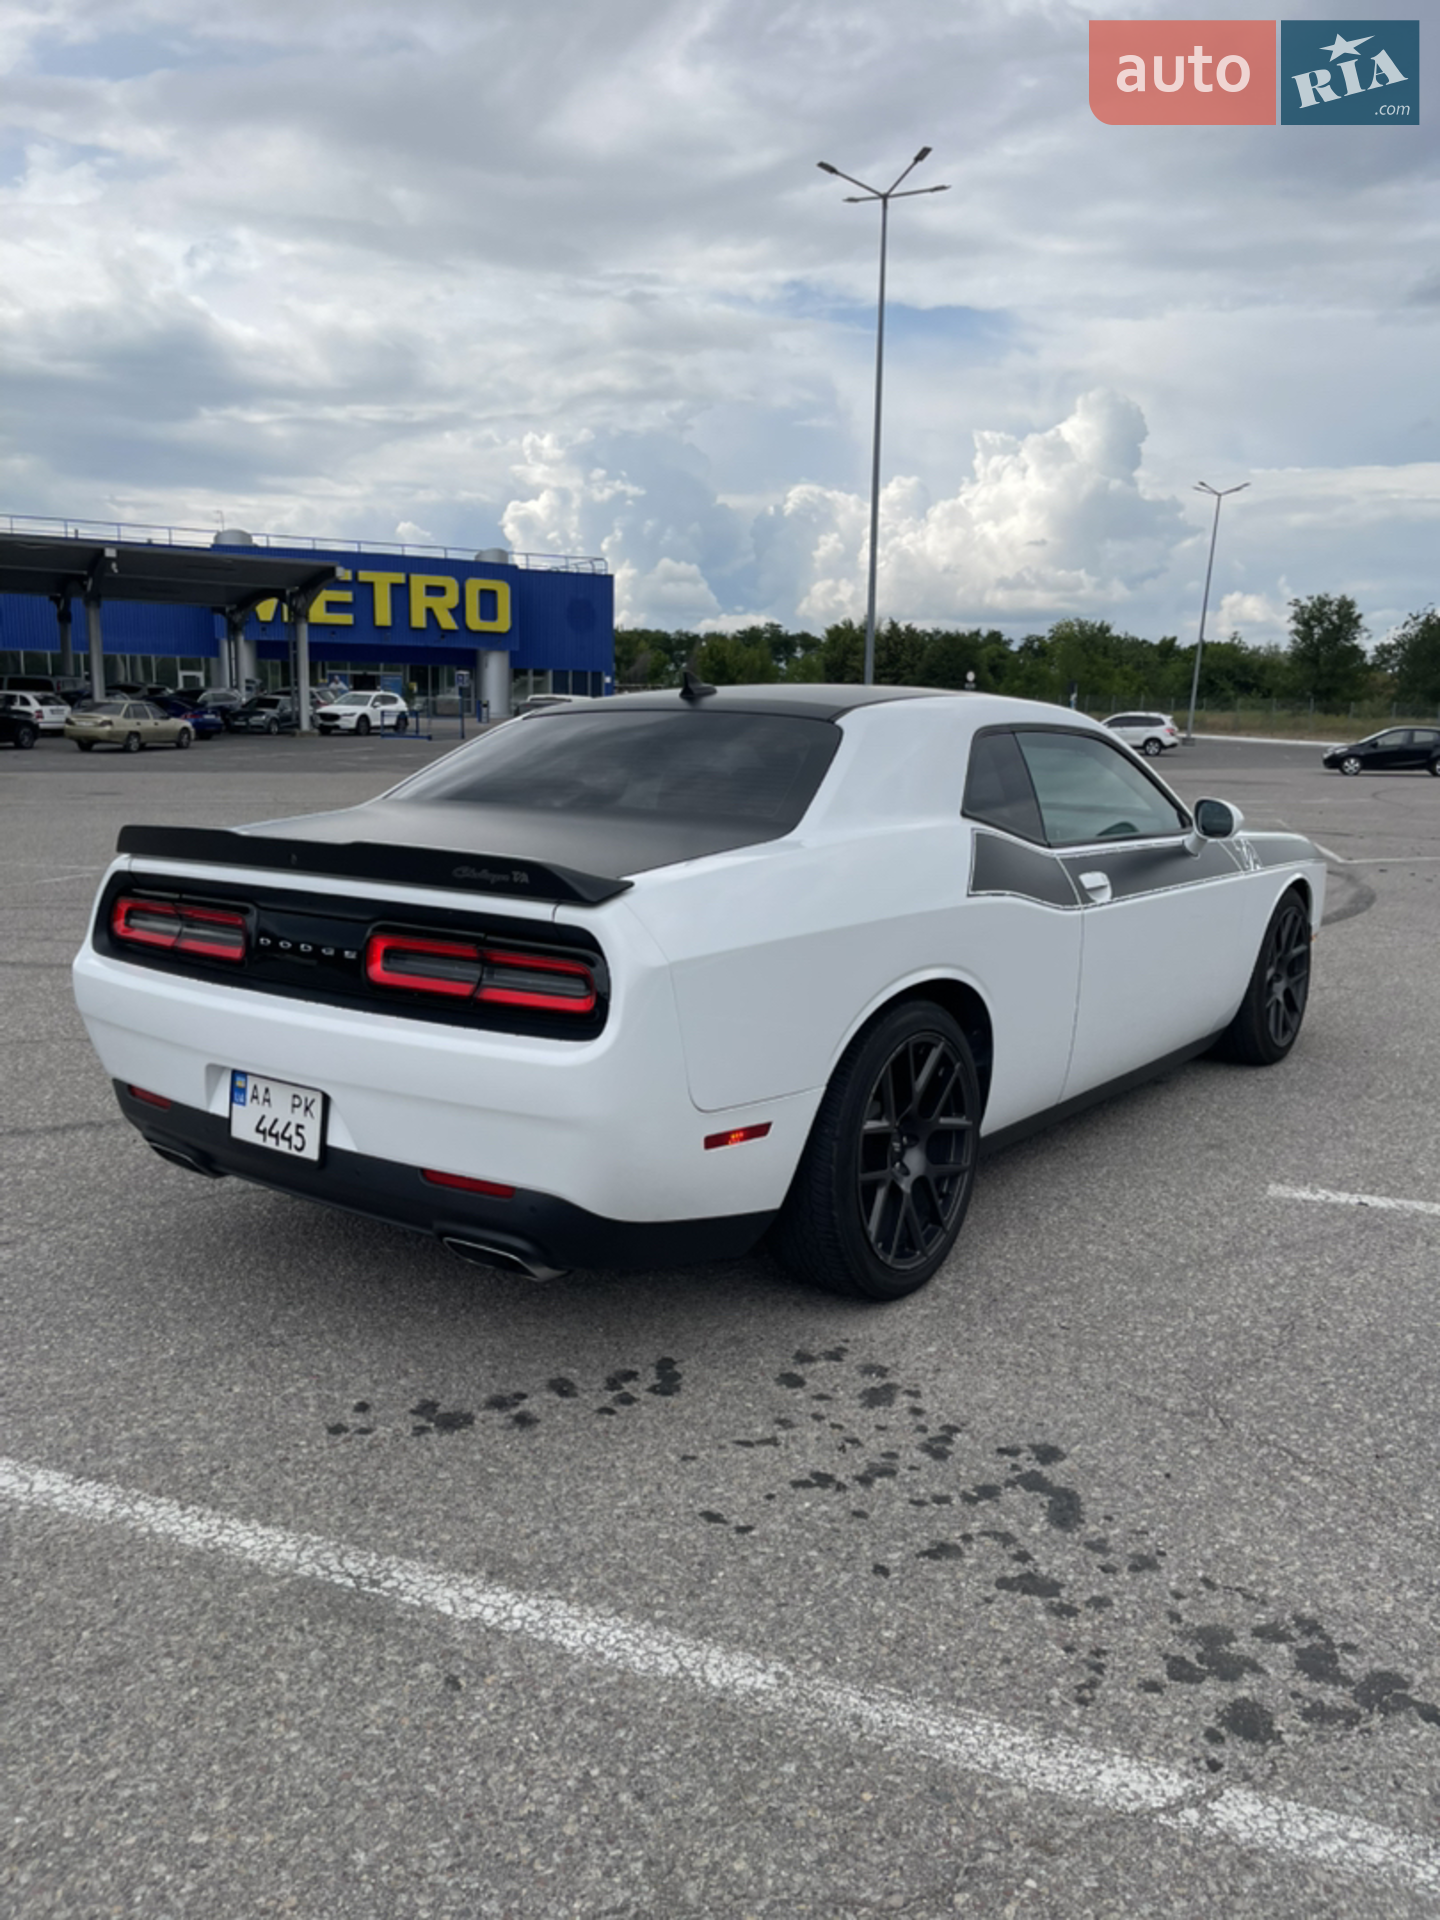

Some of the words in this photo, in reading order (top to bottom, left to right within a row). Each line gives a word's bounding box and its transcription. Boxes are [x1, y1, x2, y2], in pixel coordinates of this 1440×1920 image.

[255, 569, 512, 633] ETRO
[259, 937, 358, 959] DODGE
[250, 1083, 272, 1108] AA
[290, 1093, 316, 1119] PK
[255, 1114, 306, 1152] 4445
